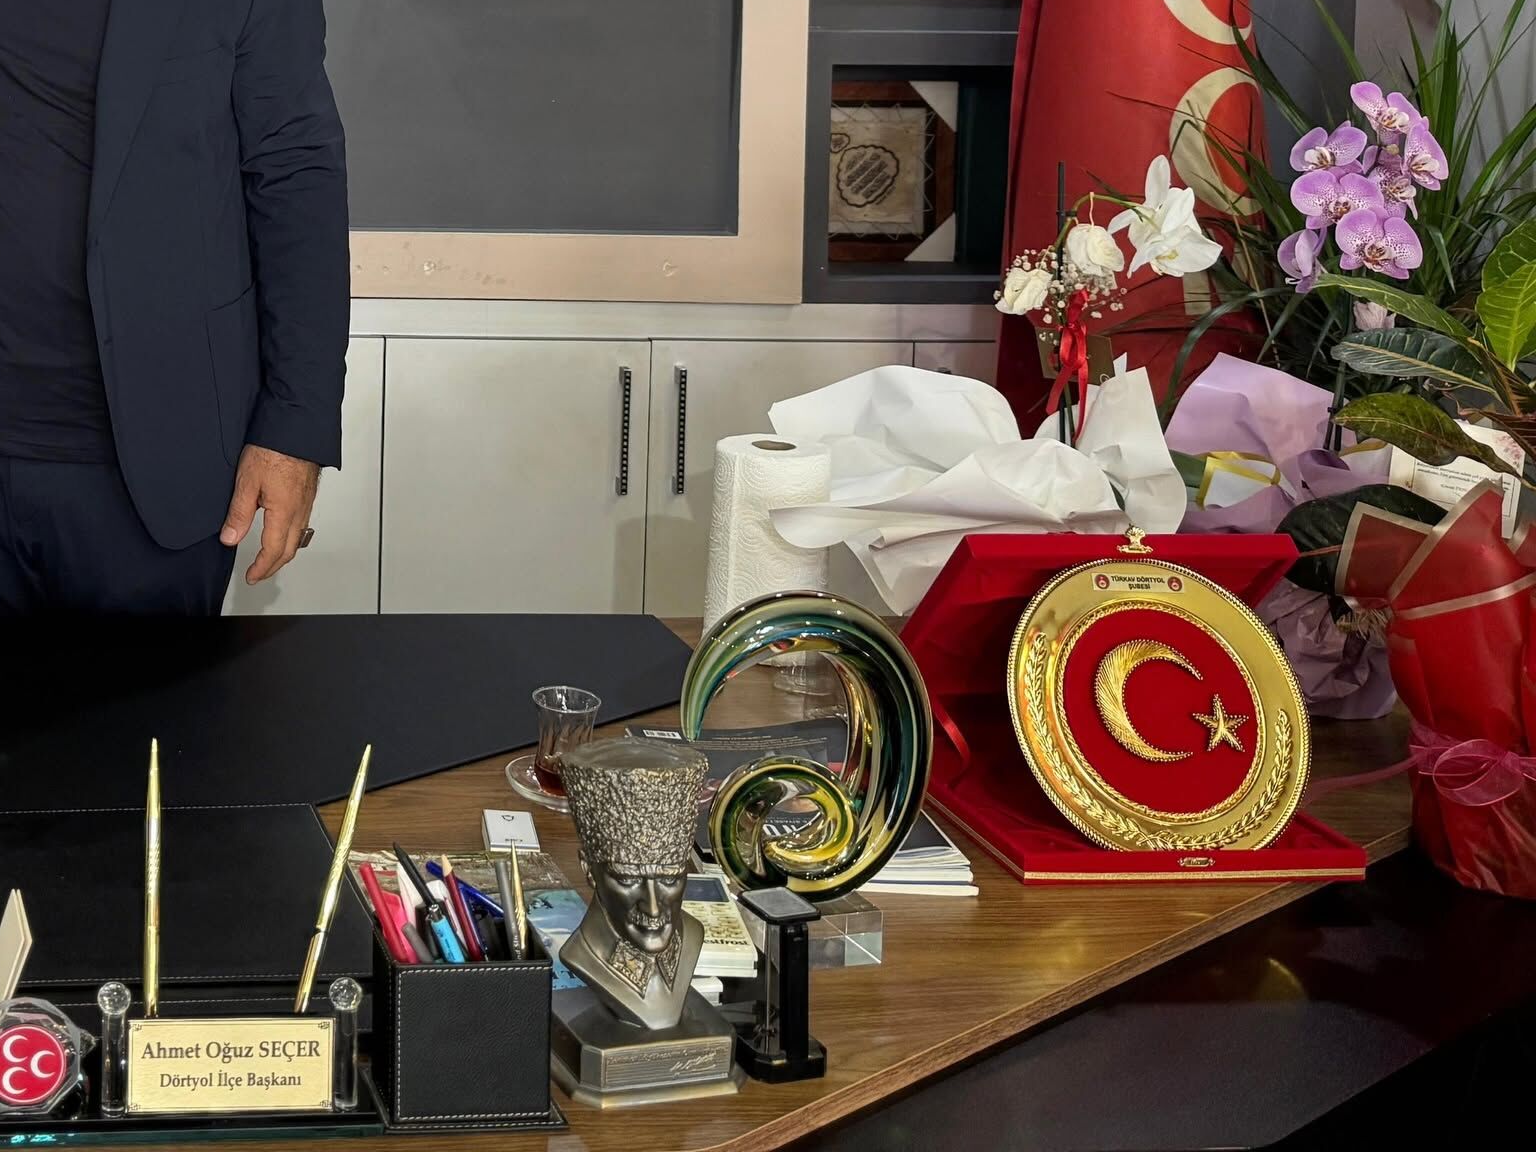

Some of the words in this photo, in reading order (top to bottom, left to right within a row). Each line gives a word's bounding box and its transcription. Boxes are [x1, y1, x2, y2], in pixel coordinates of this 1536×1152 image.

[704, 938, 748, 946] estfrost
[141, 1042, 201, 1059] Ahmet
[206, 1041, 254, 1064] Oğuz
[259, 1041, 321, 1062] SEÇER
[160, 1073, 213, 1091] Dörtyol
[218, 1069, 243, 1091] İlçe
[247, 1072, 302, 1091] Başkanı
